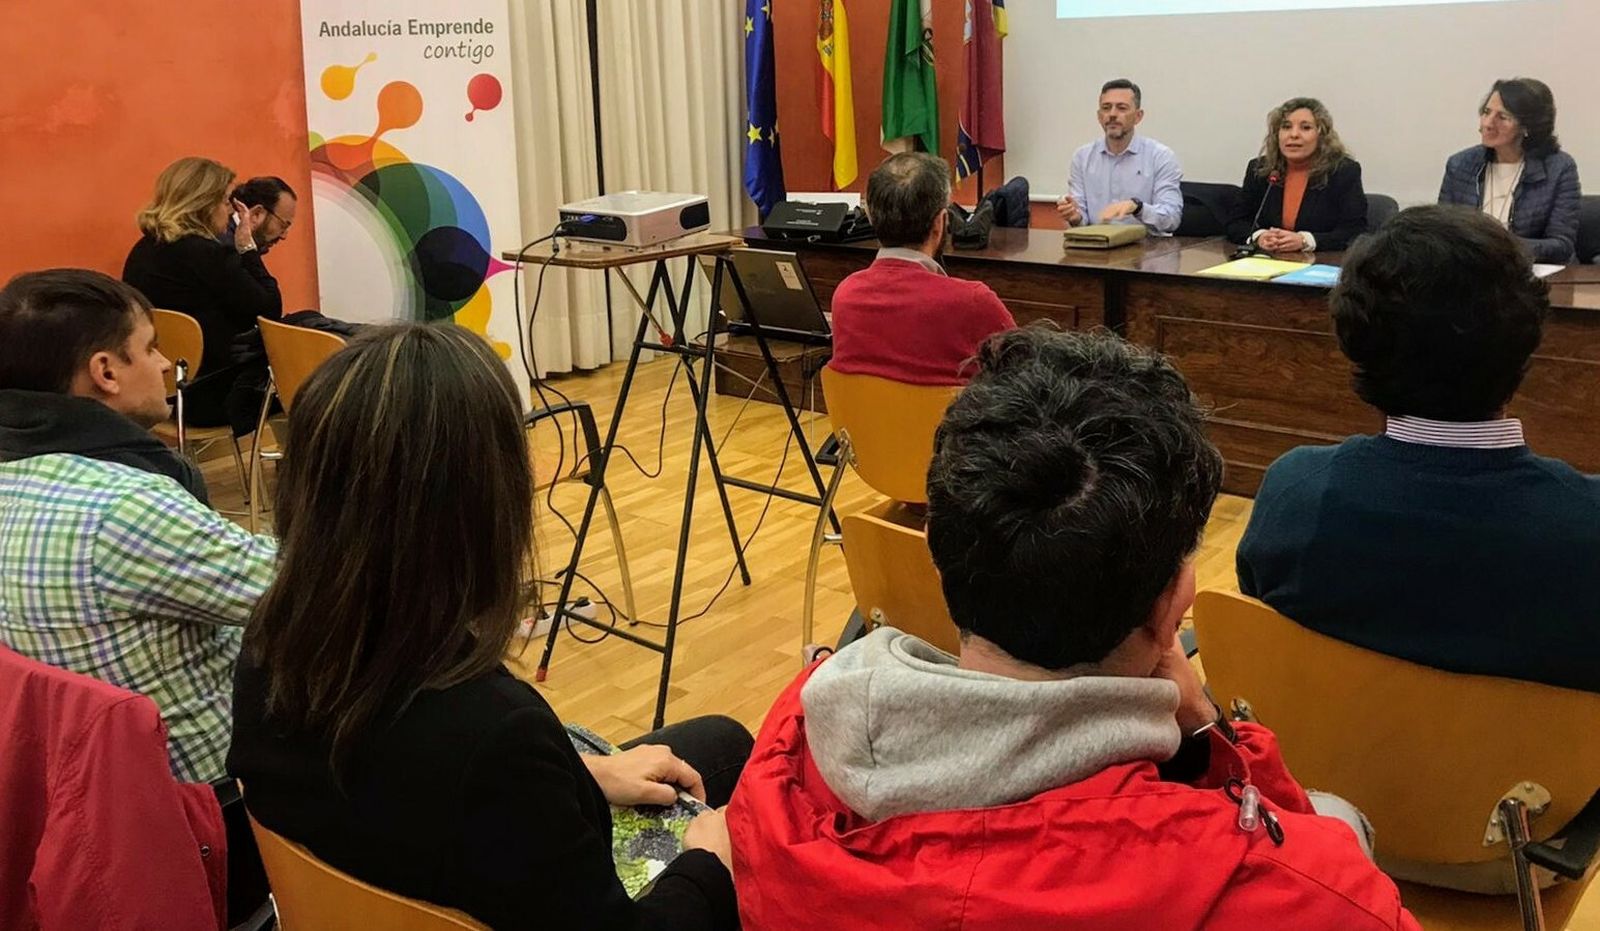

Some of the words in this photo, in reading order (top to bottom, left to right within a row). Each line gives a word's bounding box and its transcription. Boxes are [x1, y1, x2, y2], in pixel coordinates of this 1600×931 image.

[319, 20, 401, 37] Andalucía
[408, 18, 494, 37] Emprende
[424, 39, 495, 64] contigo
